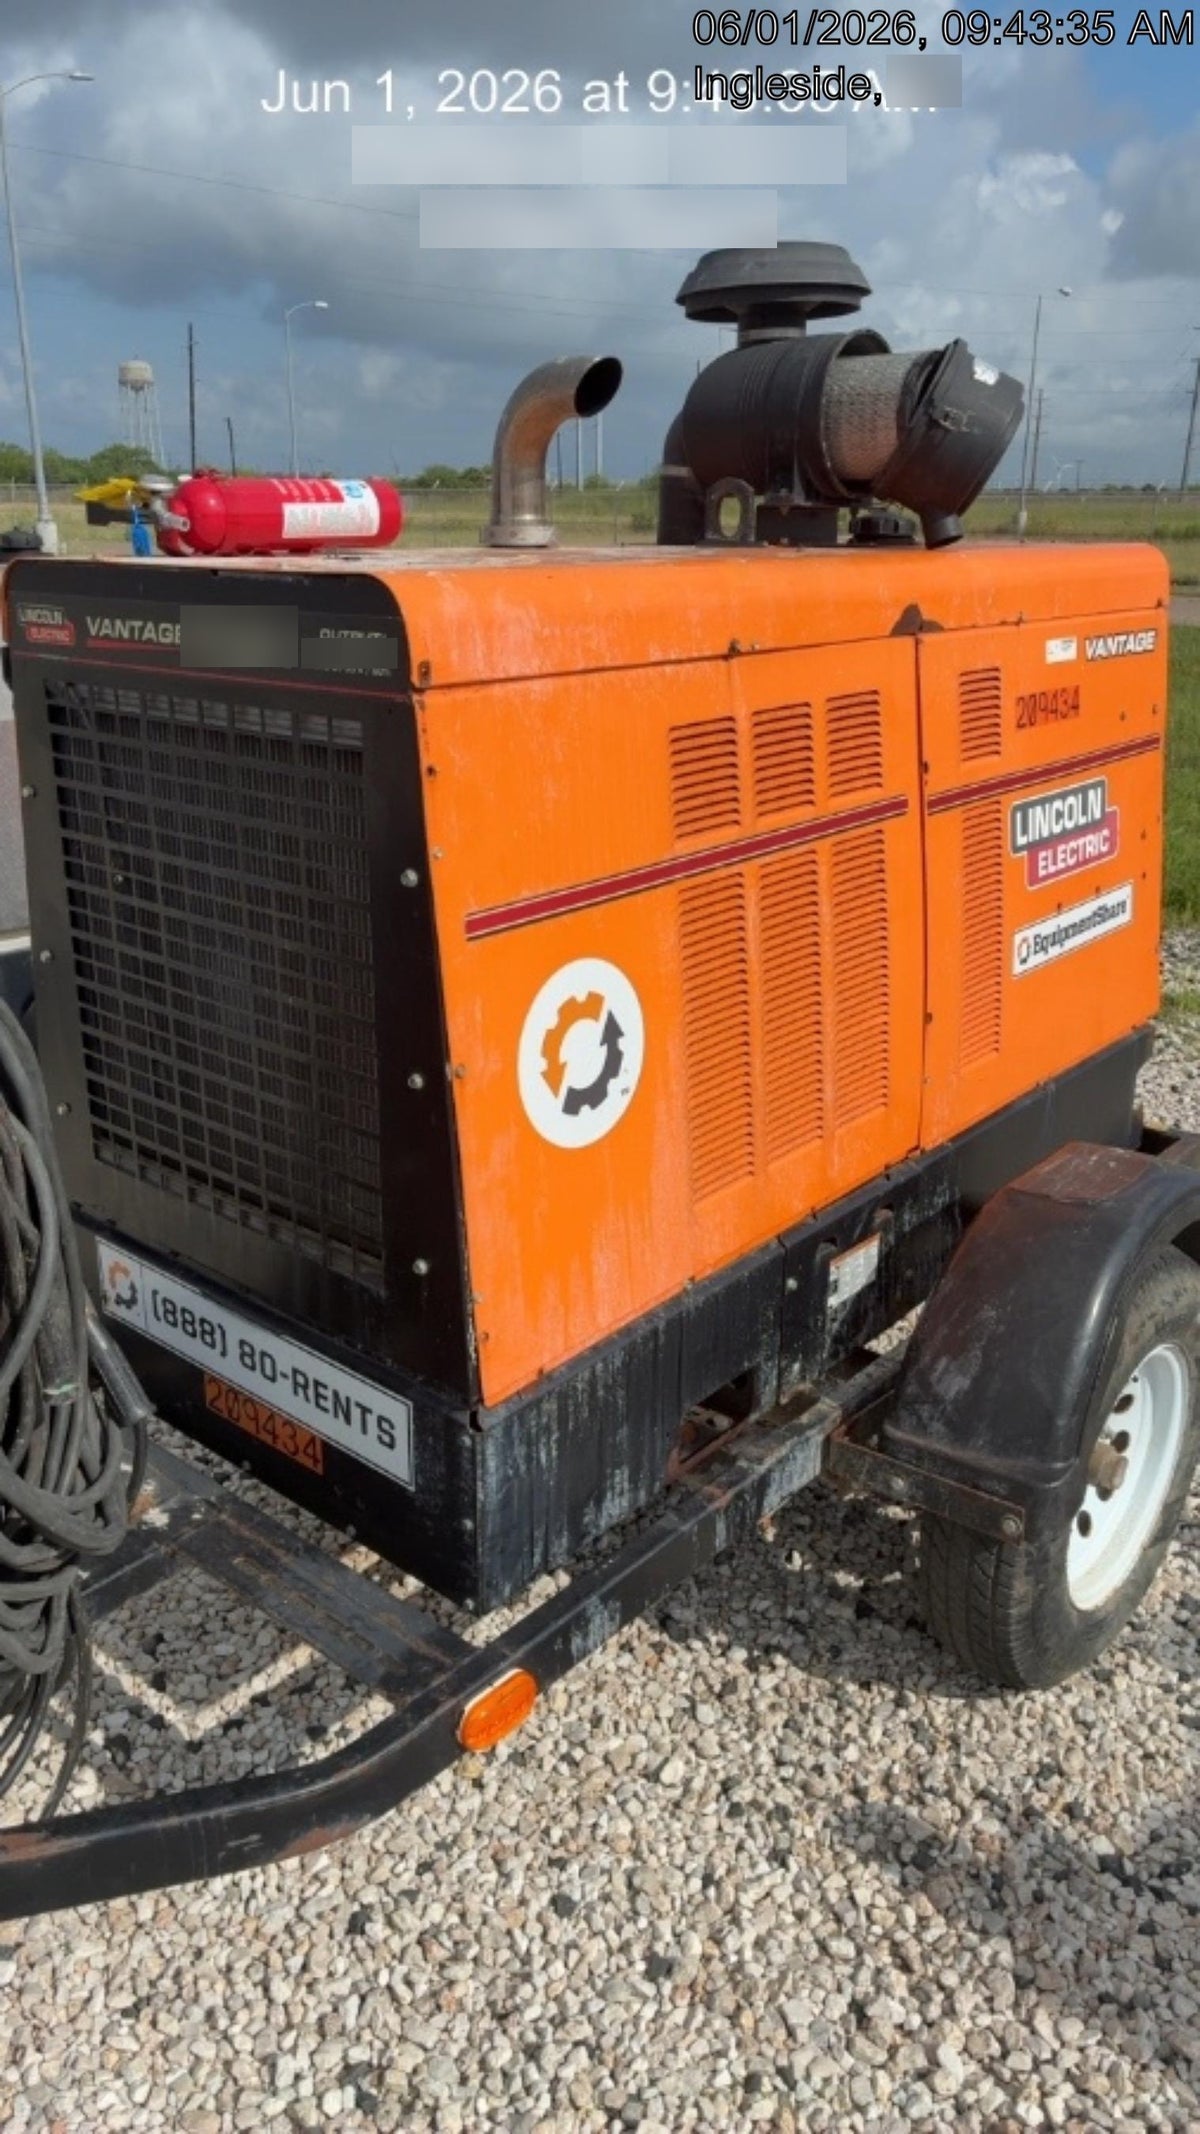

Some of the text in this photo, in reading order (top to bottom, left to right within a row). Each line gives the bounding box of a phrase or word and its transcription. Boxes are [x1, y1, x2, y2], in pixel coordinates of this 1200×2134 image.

[1084, 629, 1157, 661] VANTAGE
[1015, 684, 1080, 729] 209434
[1016, 787, 1102, 847] LINCOLN
[1038, 828, 1110, 878] ELECTRIC
[1033, 899, 1127, 956] EquipmentShare
[151, 1289, 397, 1451] (888) 80-RENTS
[207, 1377, 321, 1469] 209434
